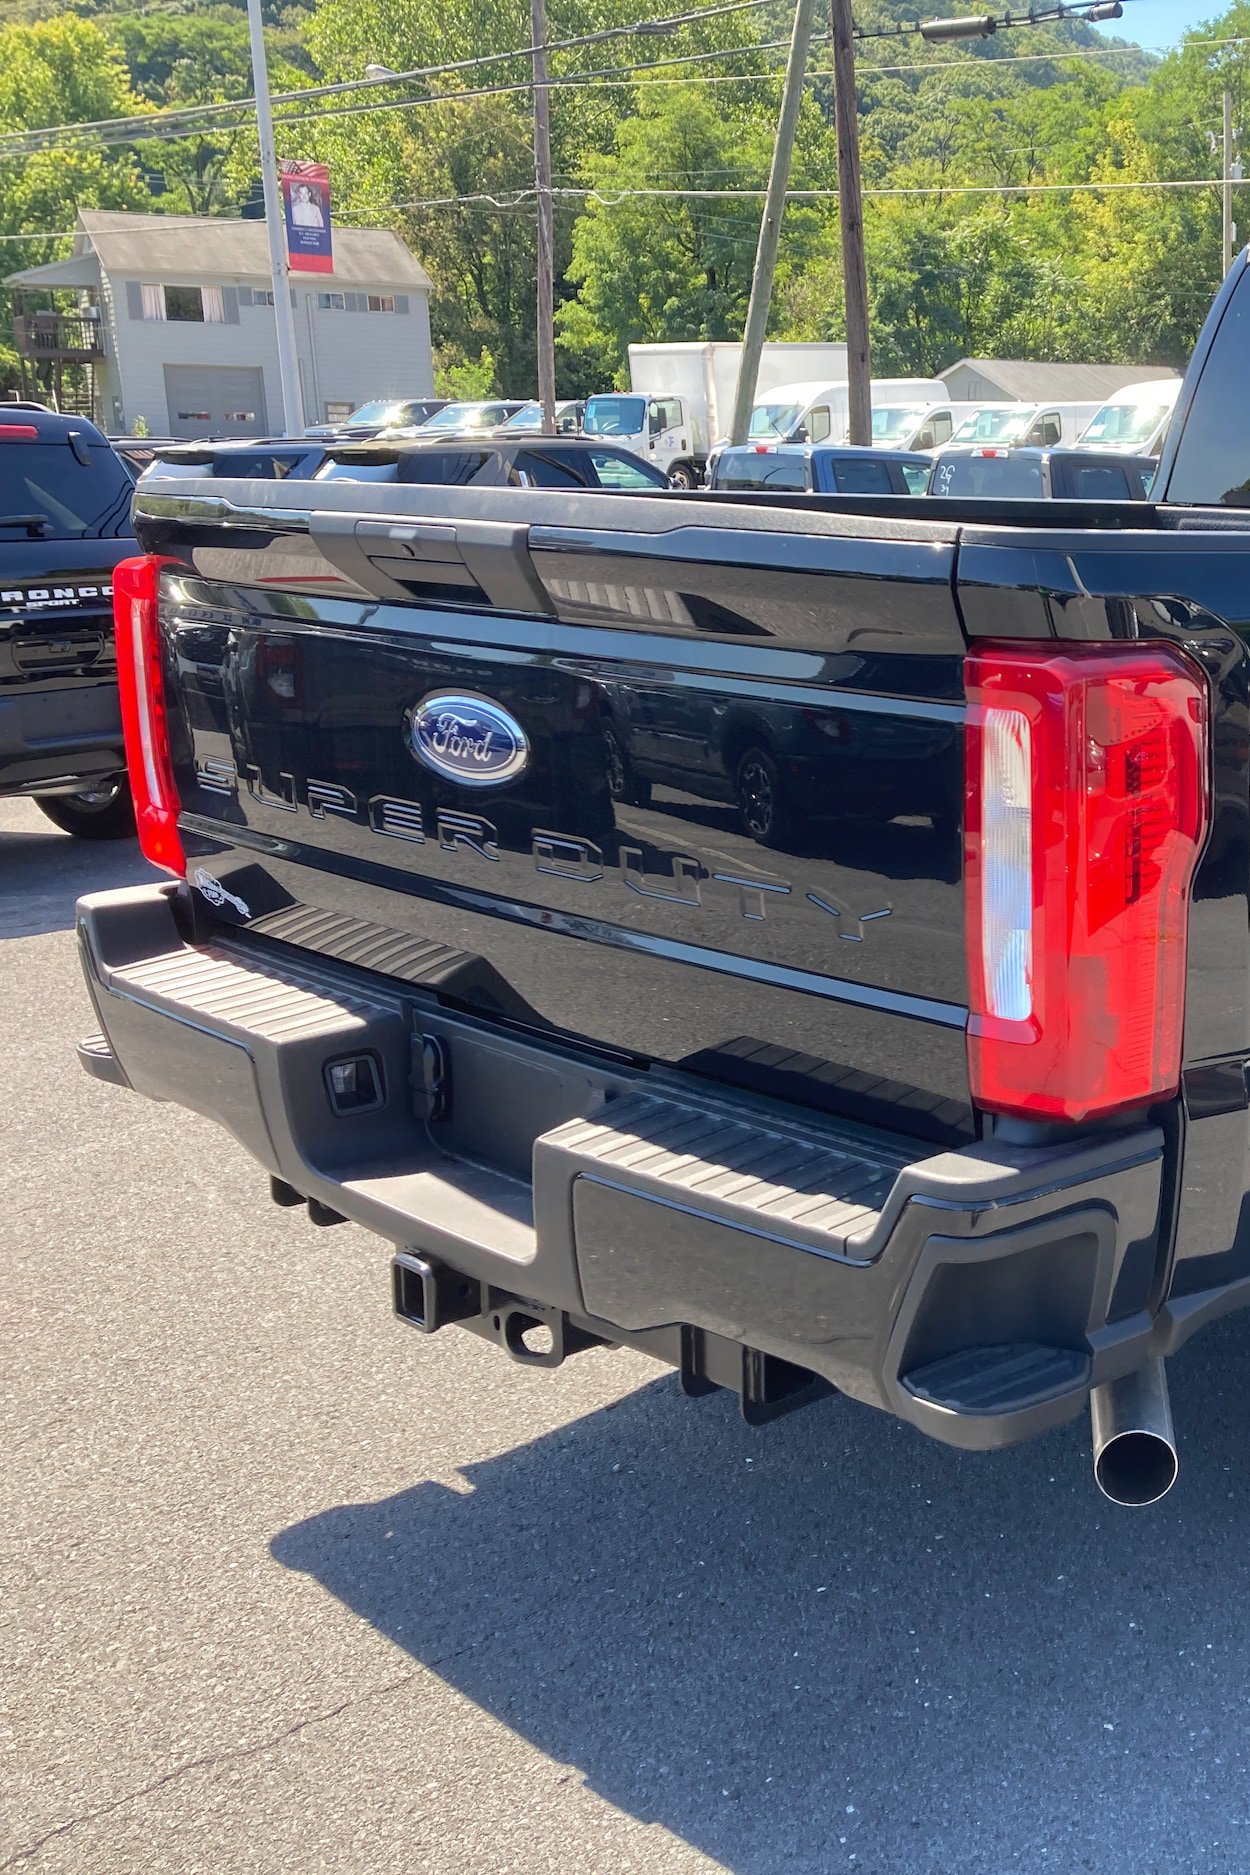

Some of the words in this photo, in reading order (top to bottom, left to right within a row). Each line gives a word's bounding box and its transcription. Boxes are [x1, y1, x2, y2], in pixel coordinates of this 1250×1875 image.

[0, 585, 114, 602] RONCO
[26, 598, 80, 608] SPORT
[196, 758, 500, 861] SUPER
[530, 826, 893, 942] DUTY
